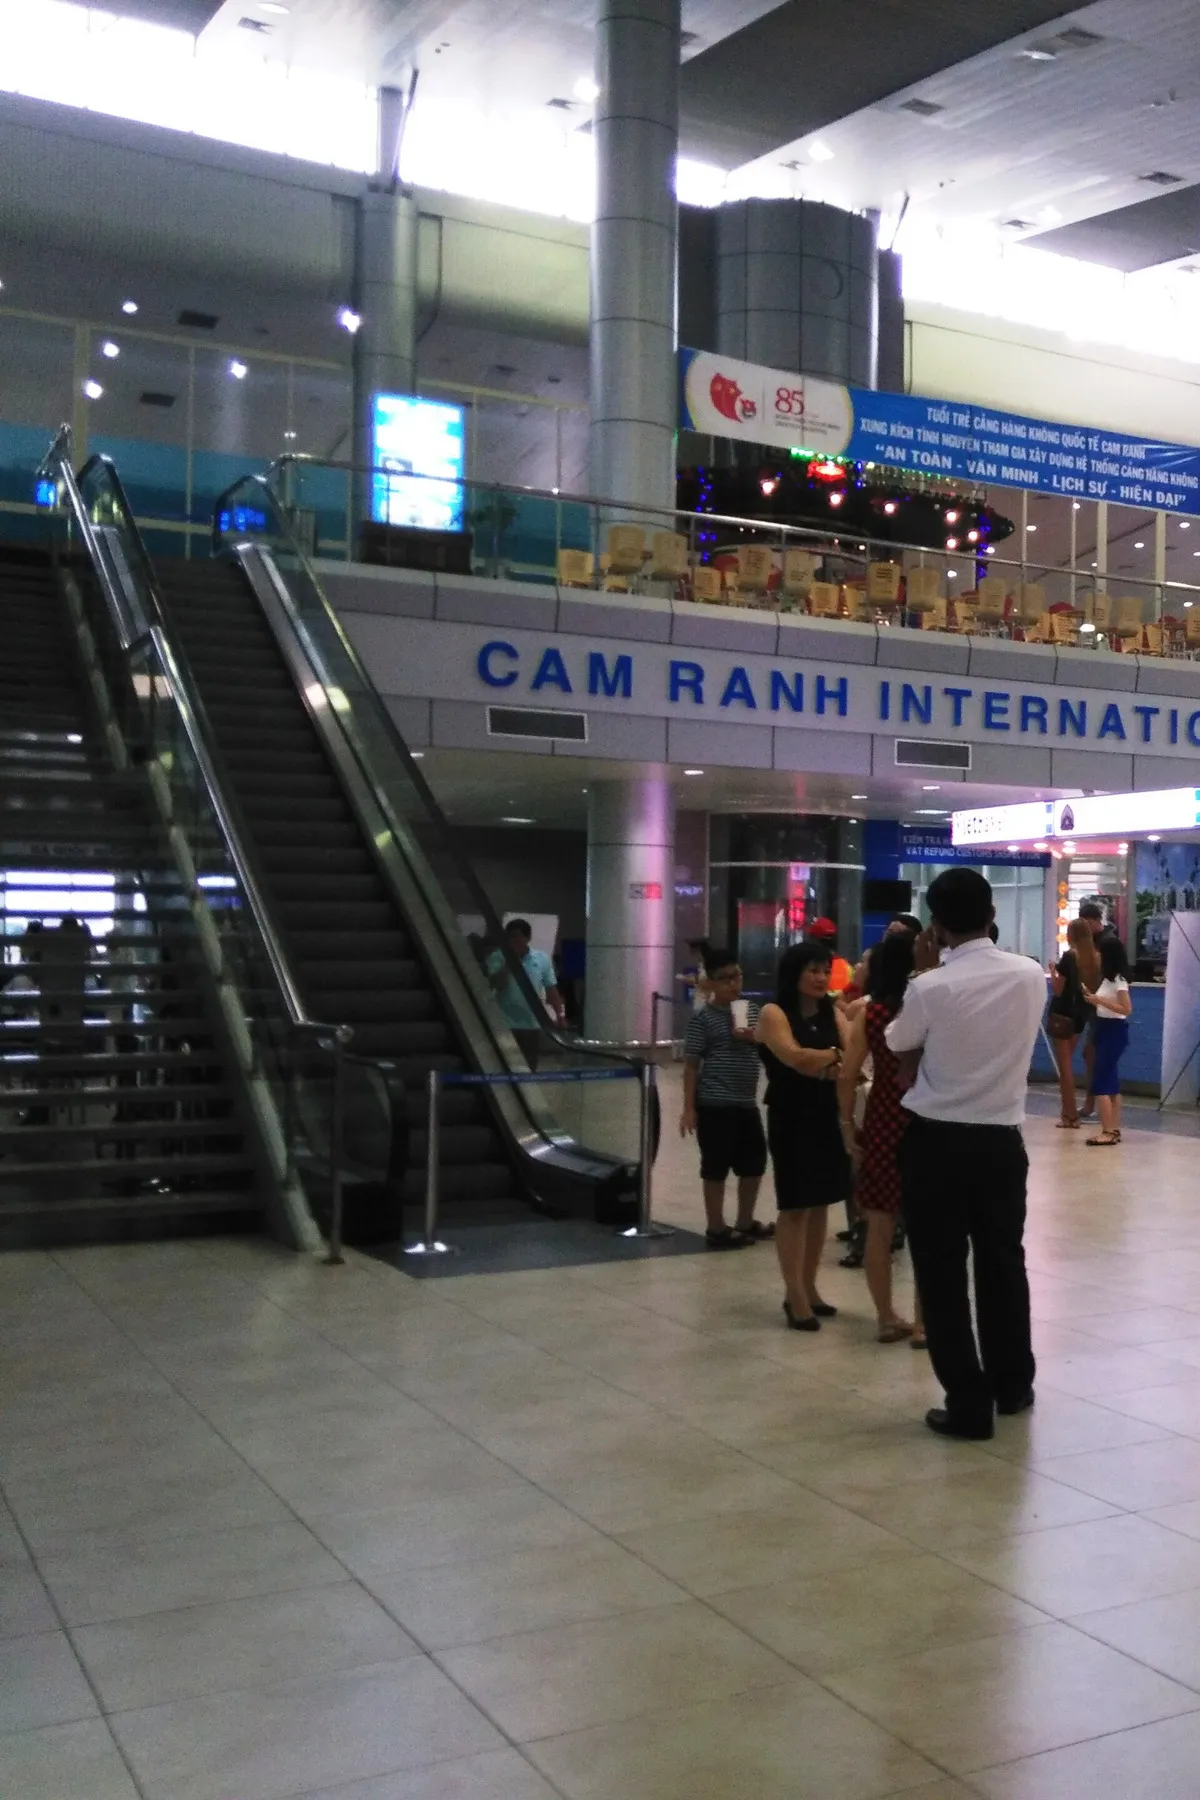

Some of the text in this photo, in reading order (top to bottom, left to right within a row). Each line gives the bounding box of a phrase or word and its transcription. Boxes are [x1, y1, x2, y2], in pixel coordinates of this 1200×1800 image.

[775, 387, 805, 415] 85
[1001, 466, 1039, 484] MINH
[477, 640, 634, 698] CAM
[669, 660, 849, 717] RANH
